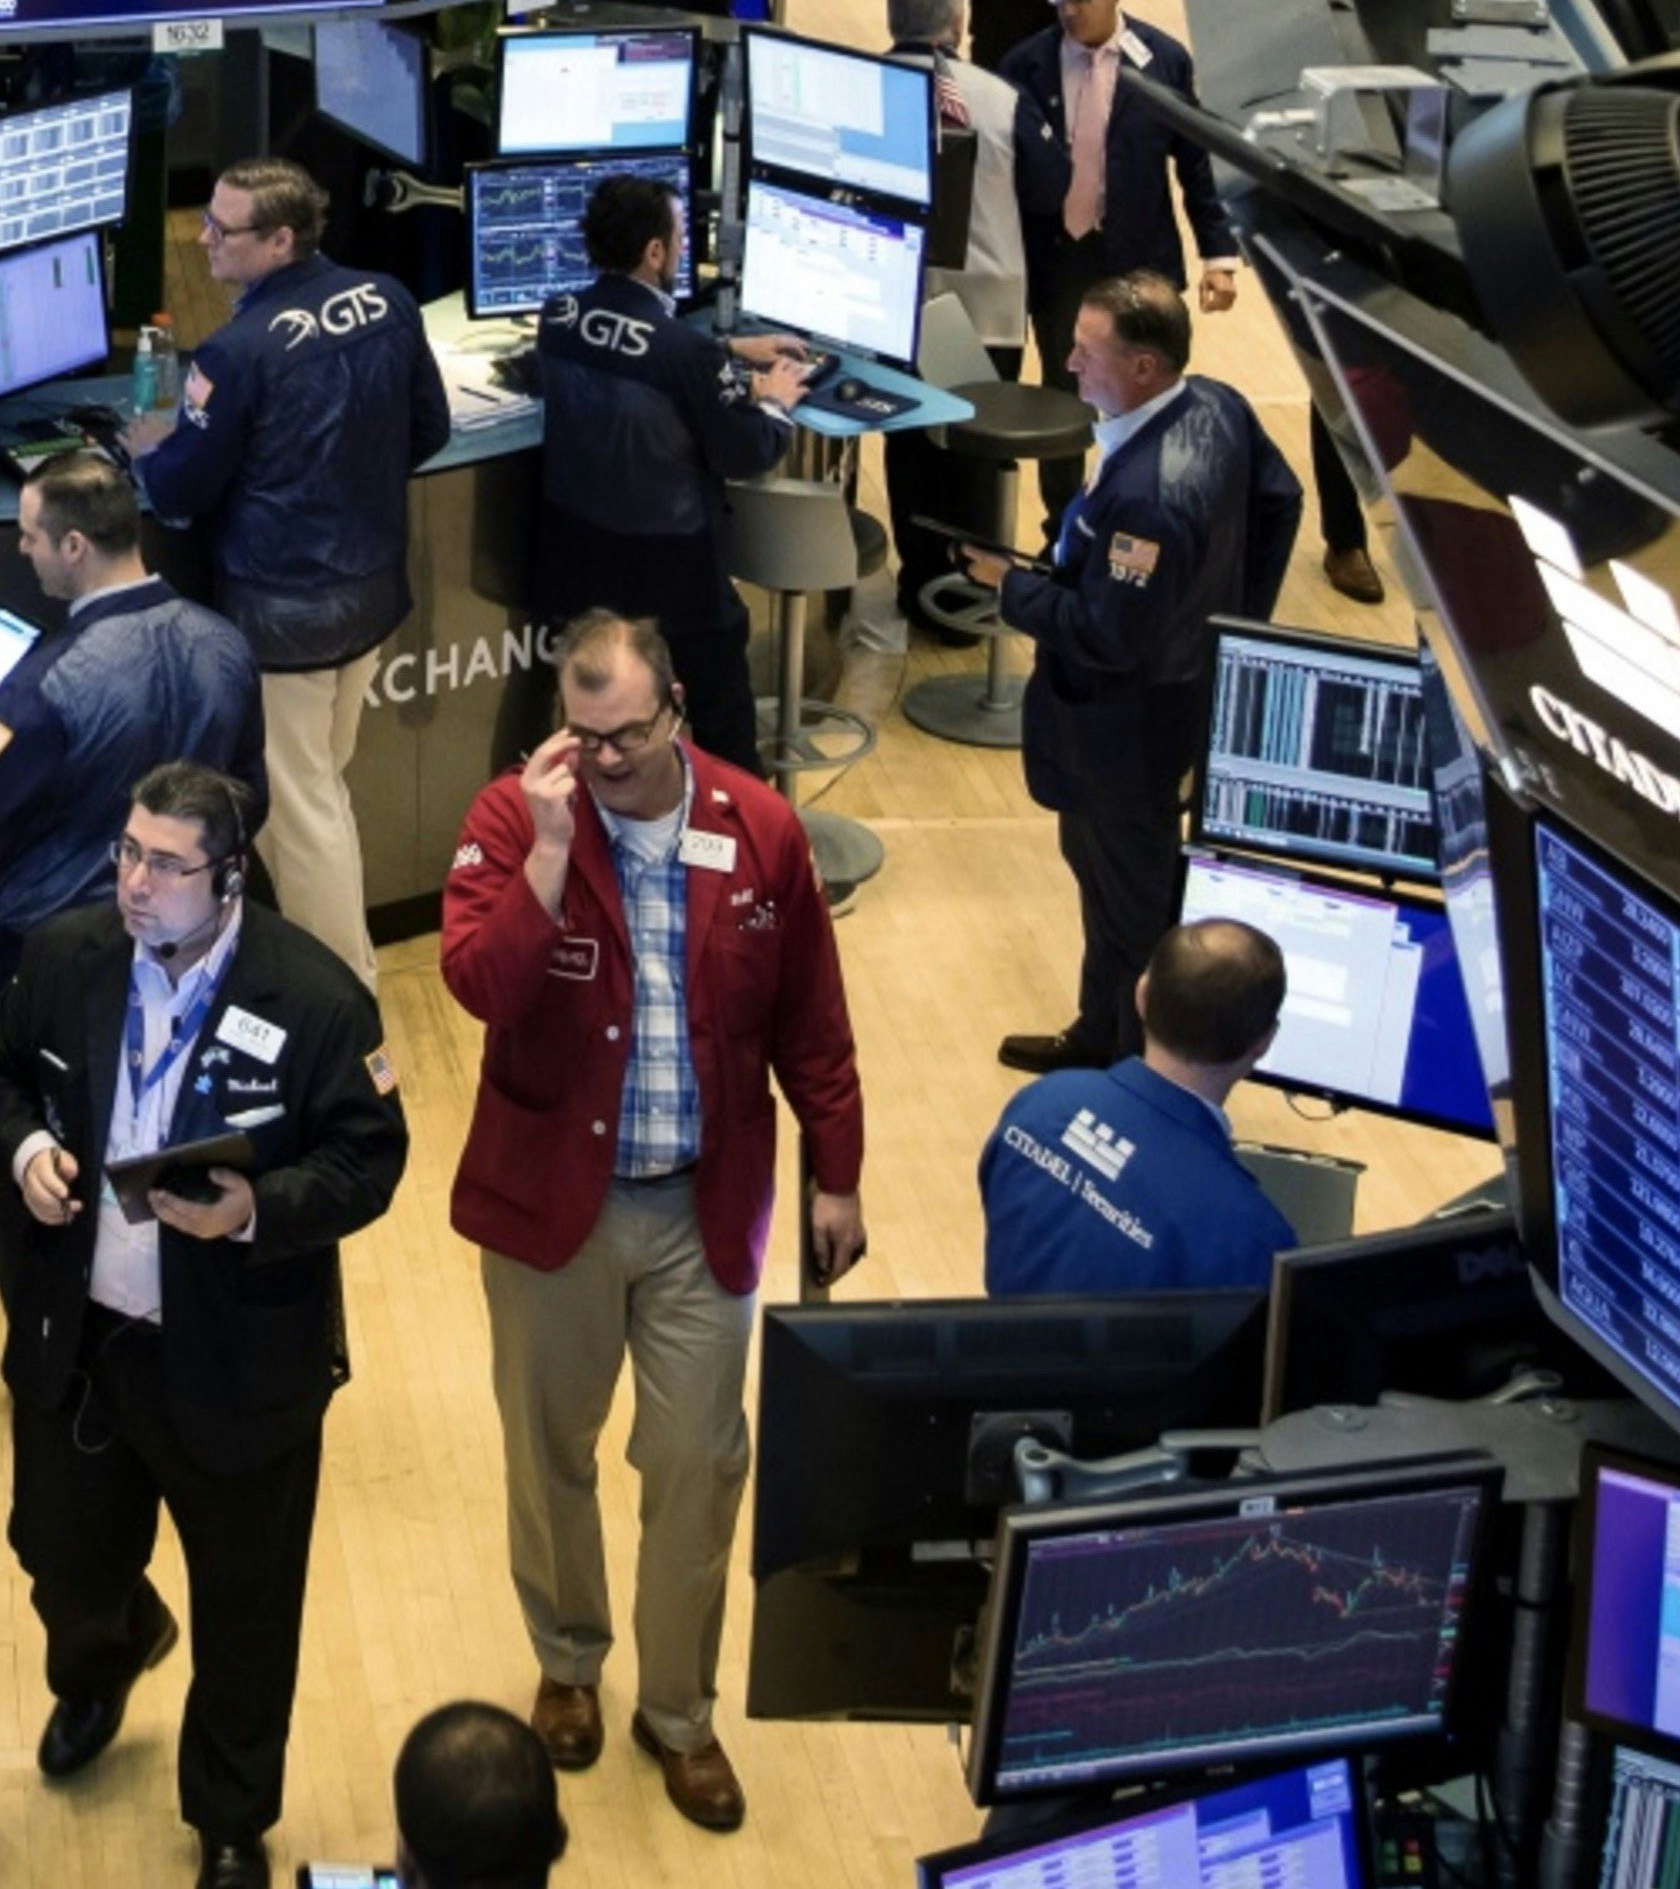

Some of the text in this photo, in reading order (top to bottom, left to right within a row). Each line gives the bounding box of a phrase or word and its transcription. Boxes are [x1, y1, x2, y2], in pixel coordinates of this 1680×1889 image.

[319, 280, 389, 339] GTS
[579, 309, 656, 357] GTS
[1003, 1126, 1154, 1252] CITADEL Securities
